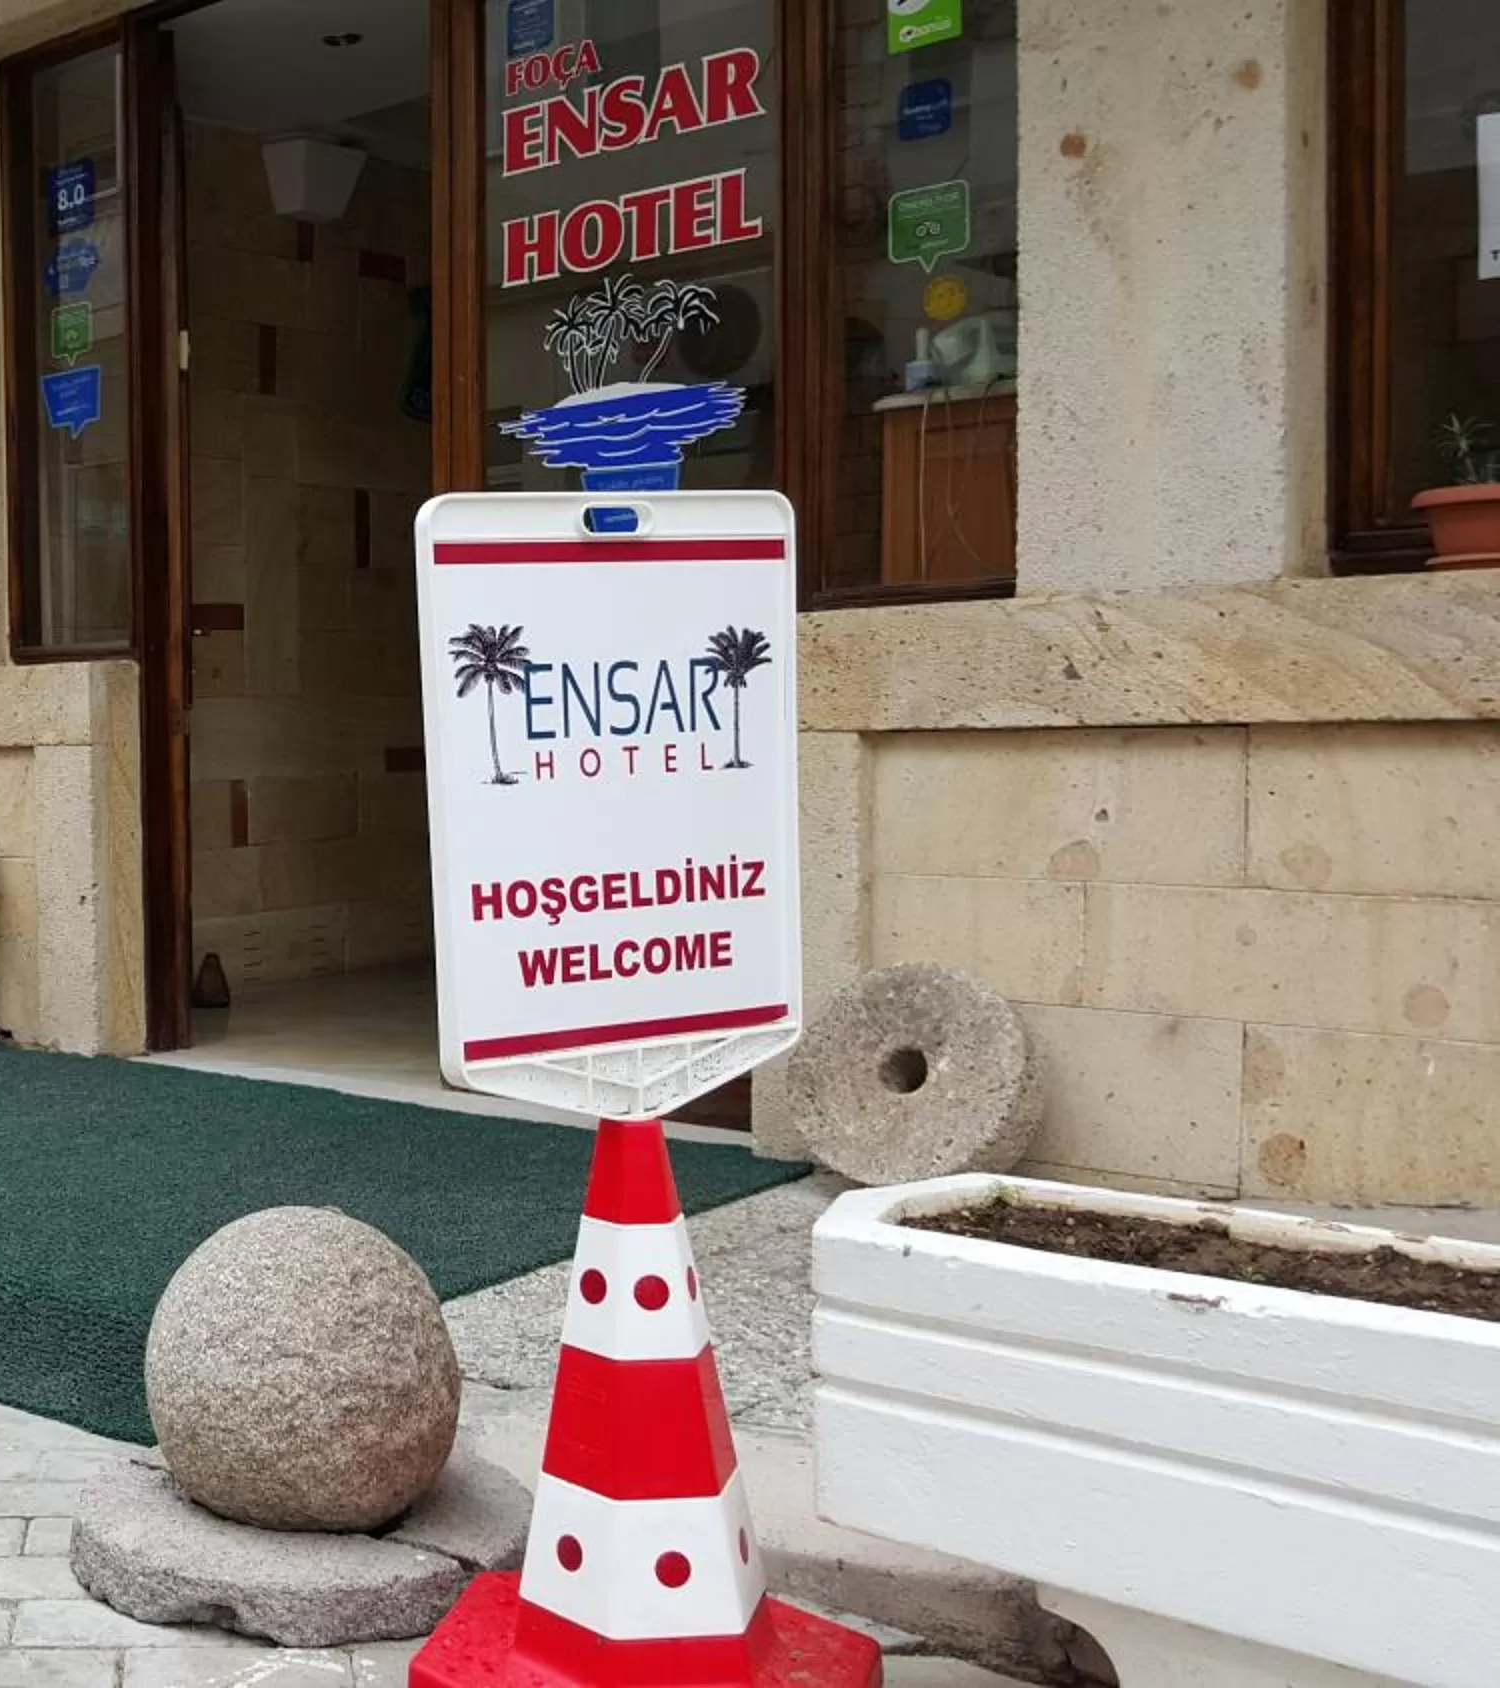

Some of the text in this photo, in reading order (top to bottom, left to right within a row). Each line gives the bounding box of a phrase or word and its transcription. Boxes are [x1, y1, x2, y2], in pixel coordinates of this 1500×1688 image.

[505, 39, 602, 96] FOÇA
[502, 47, 765, 177] ENSAR
[58, 183, 86, 211] 8.0
[502, 168, 762, 287] HOTEL
[522, 658, 722, 740] ENSAR
[534, 743, 713, 780] HOTEL
[471, 853, 766, 925] HOŞGELDİNİZ
[518, 930, 734, 988] WELCOME
